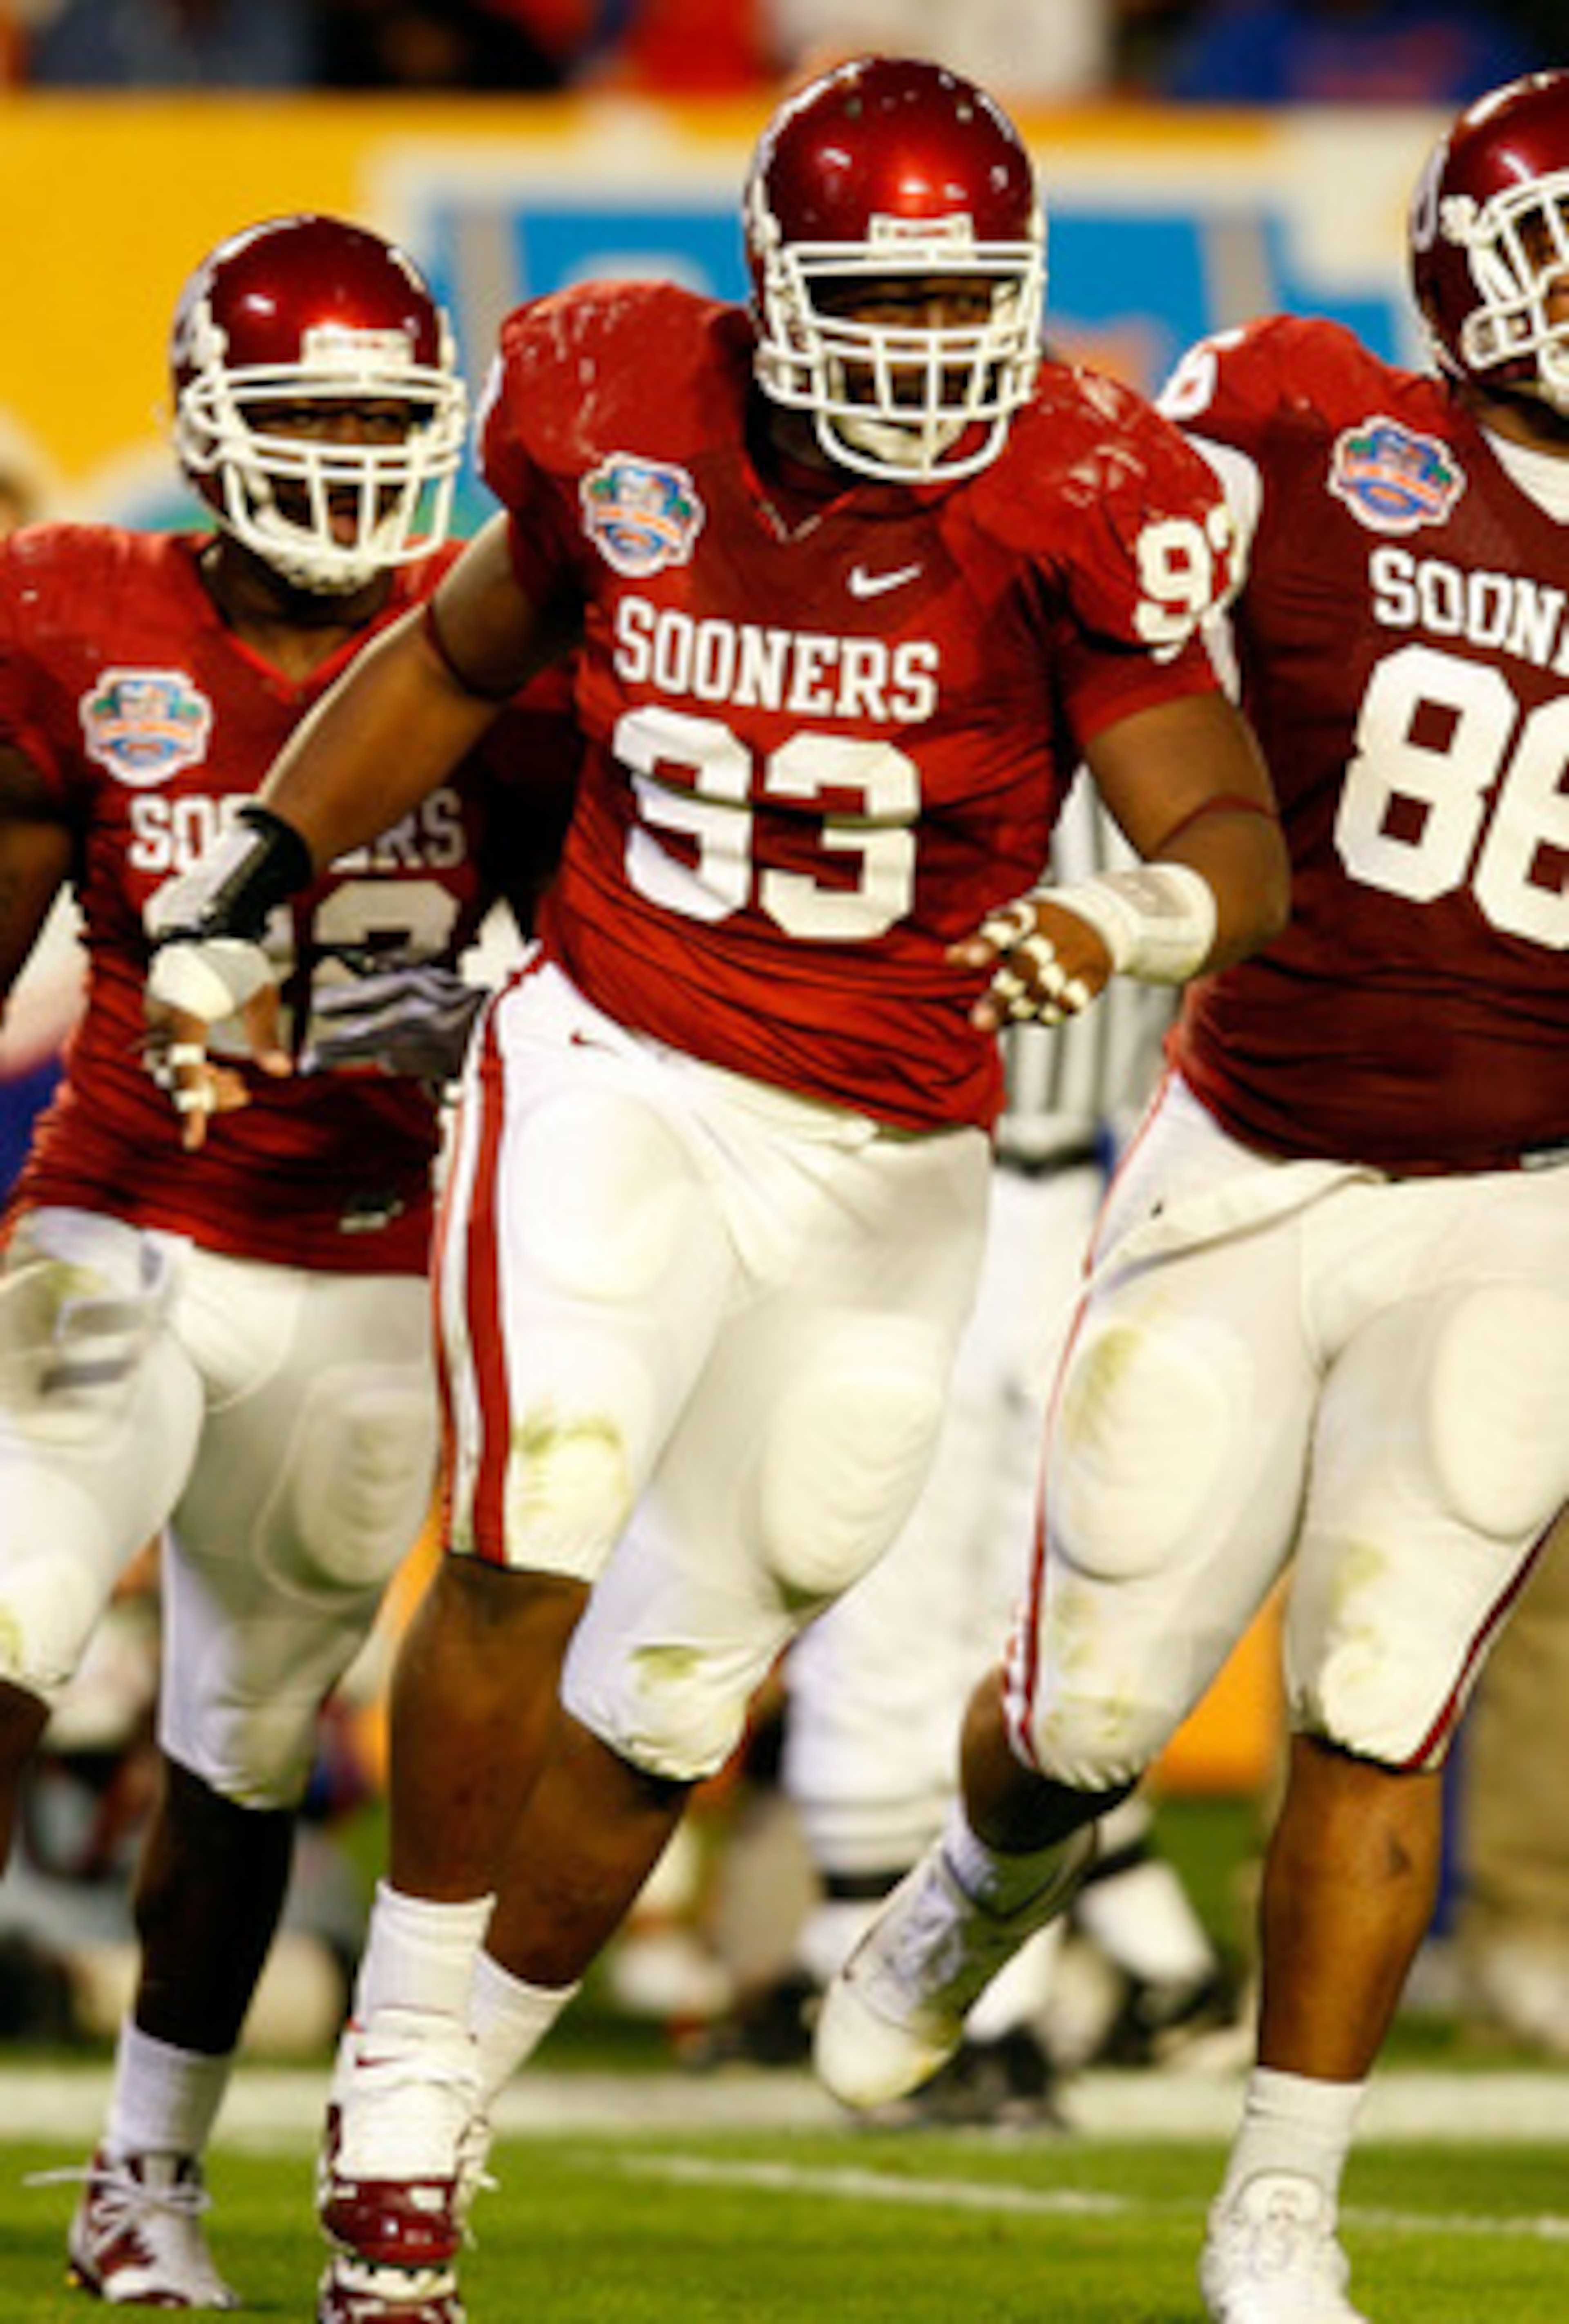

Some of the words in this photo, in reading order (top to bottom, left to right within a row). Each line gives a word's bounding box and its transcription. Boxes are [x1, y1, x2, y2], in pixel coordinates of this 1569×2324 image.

[614, 595, 940, 723] SOONERS
[1367, 545, 1569, 678] SOON
[612, 704, 921, 941] 93
